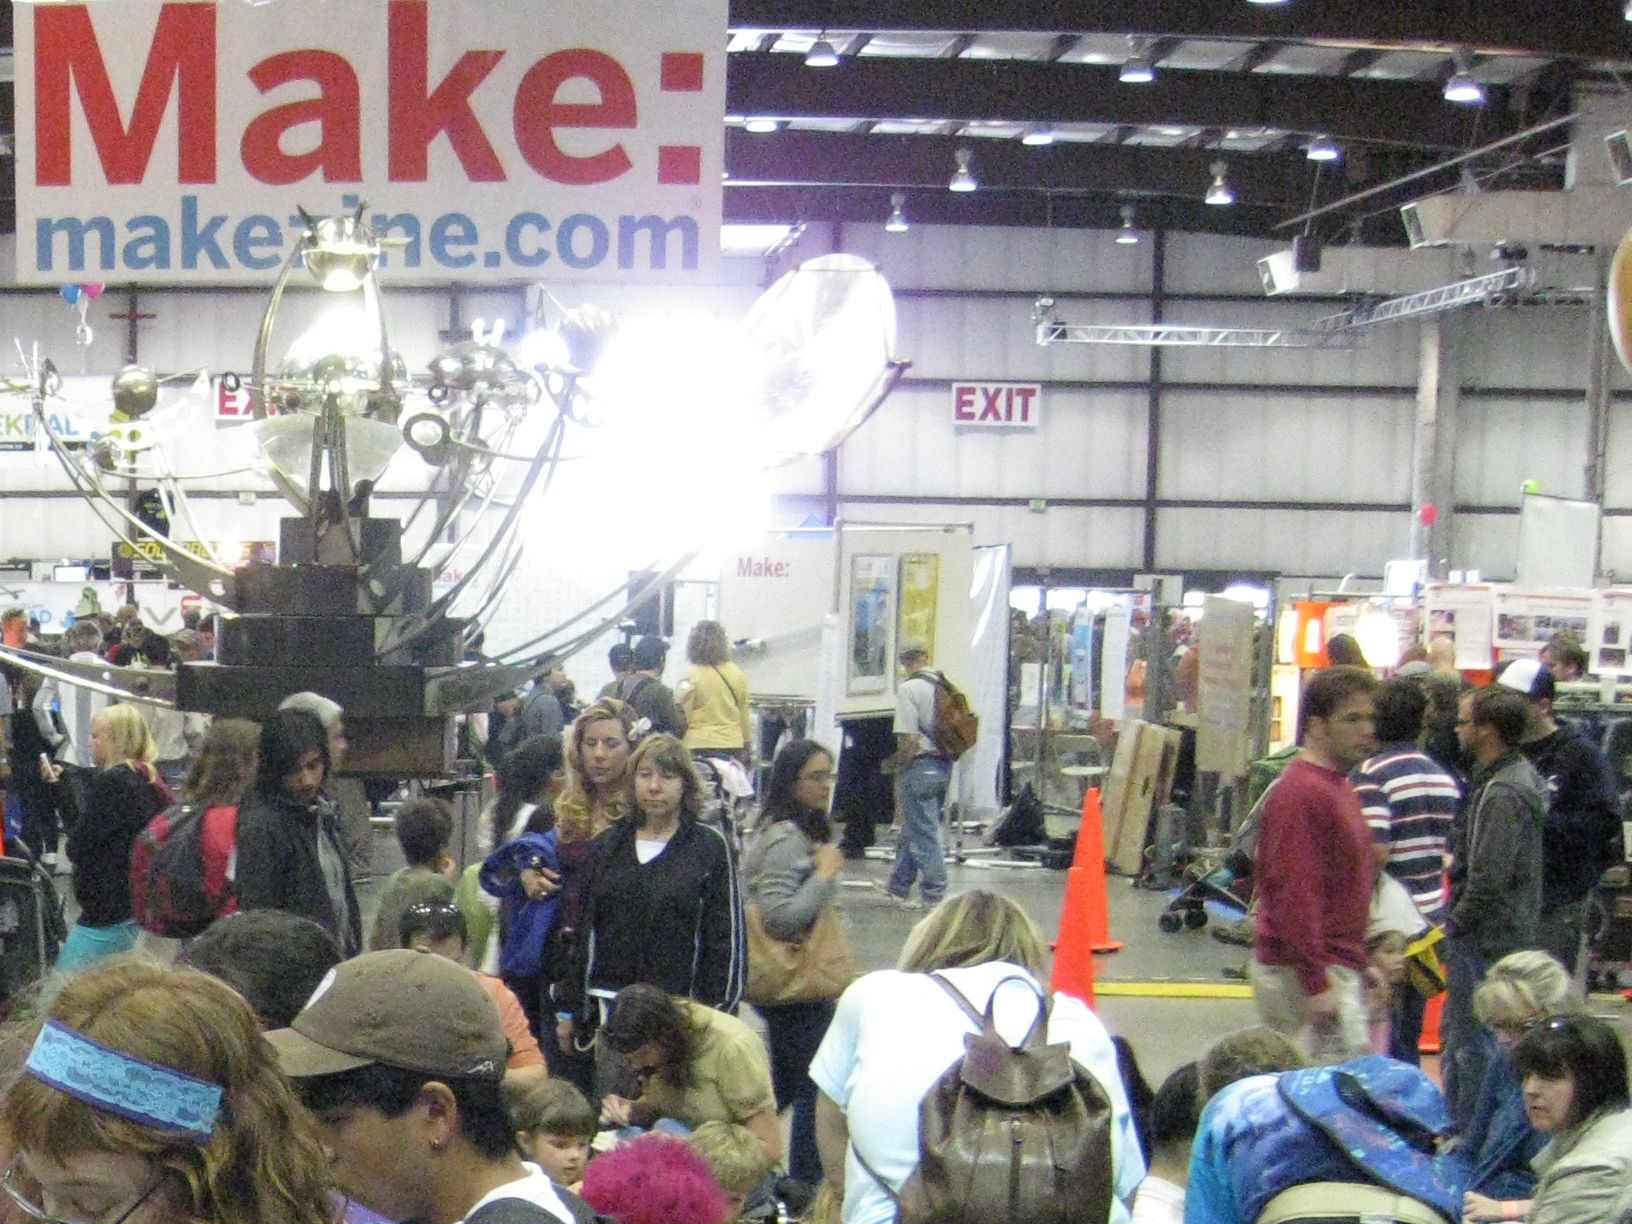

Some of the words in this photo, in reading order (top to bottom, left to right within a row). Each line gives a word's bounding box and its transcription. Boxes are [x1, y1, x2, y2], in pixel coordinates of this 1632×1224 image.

[33, 0, 704, 187] Make:
[34, 195, 701, 271] makene.com
[954, 386, 1037, 422] EXIT
[736, 556, 790, 577] Make:
